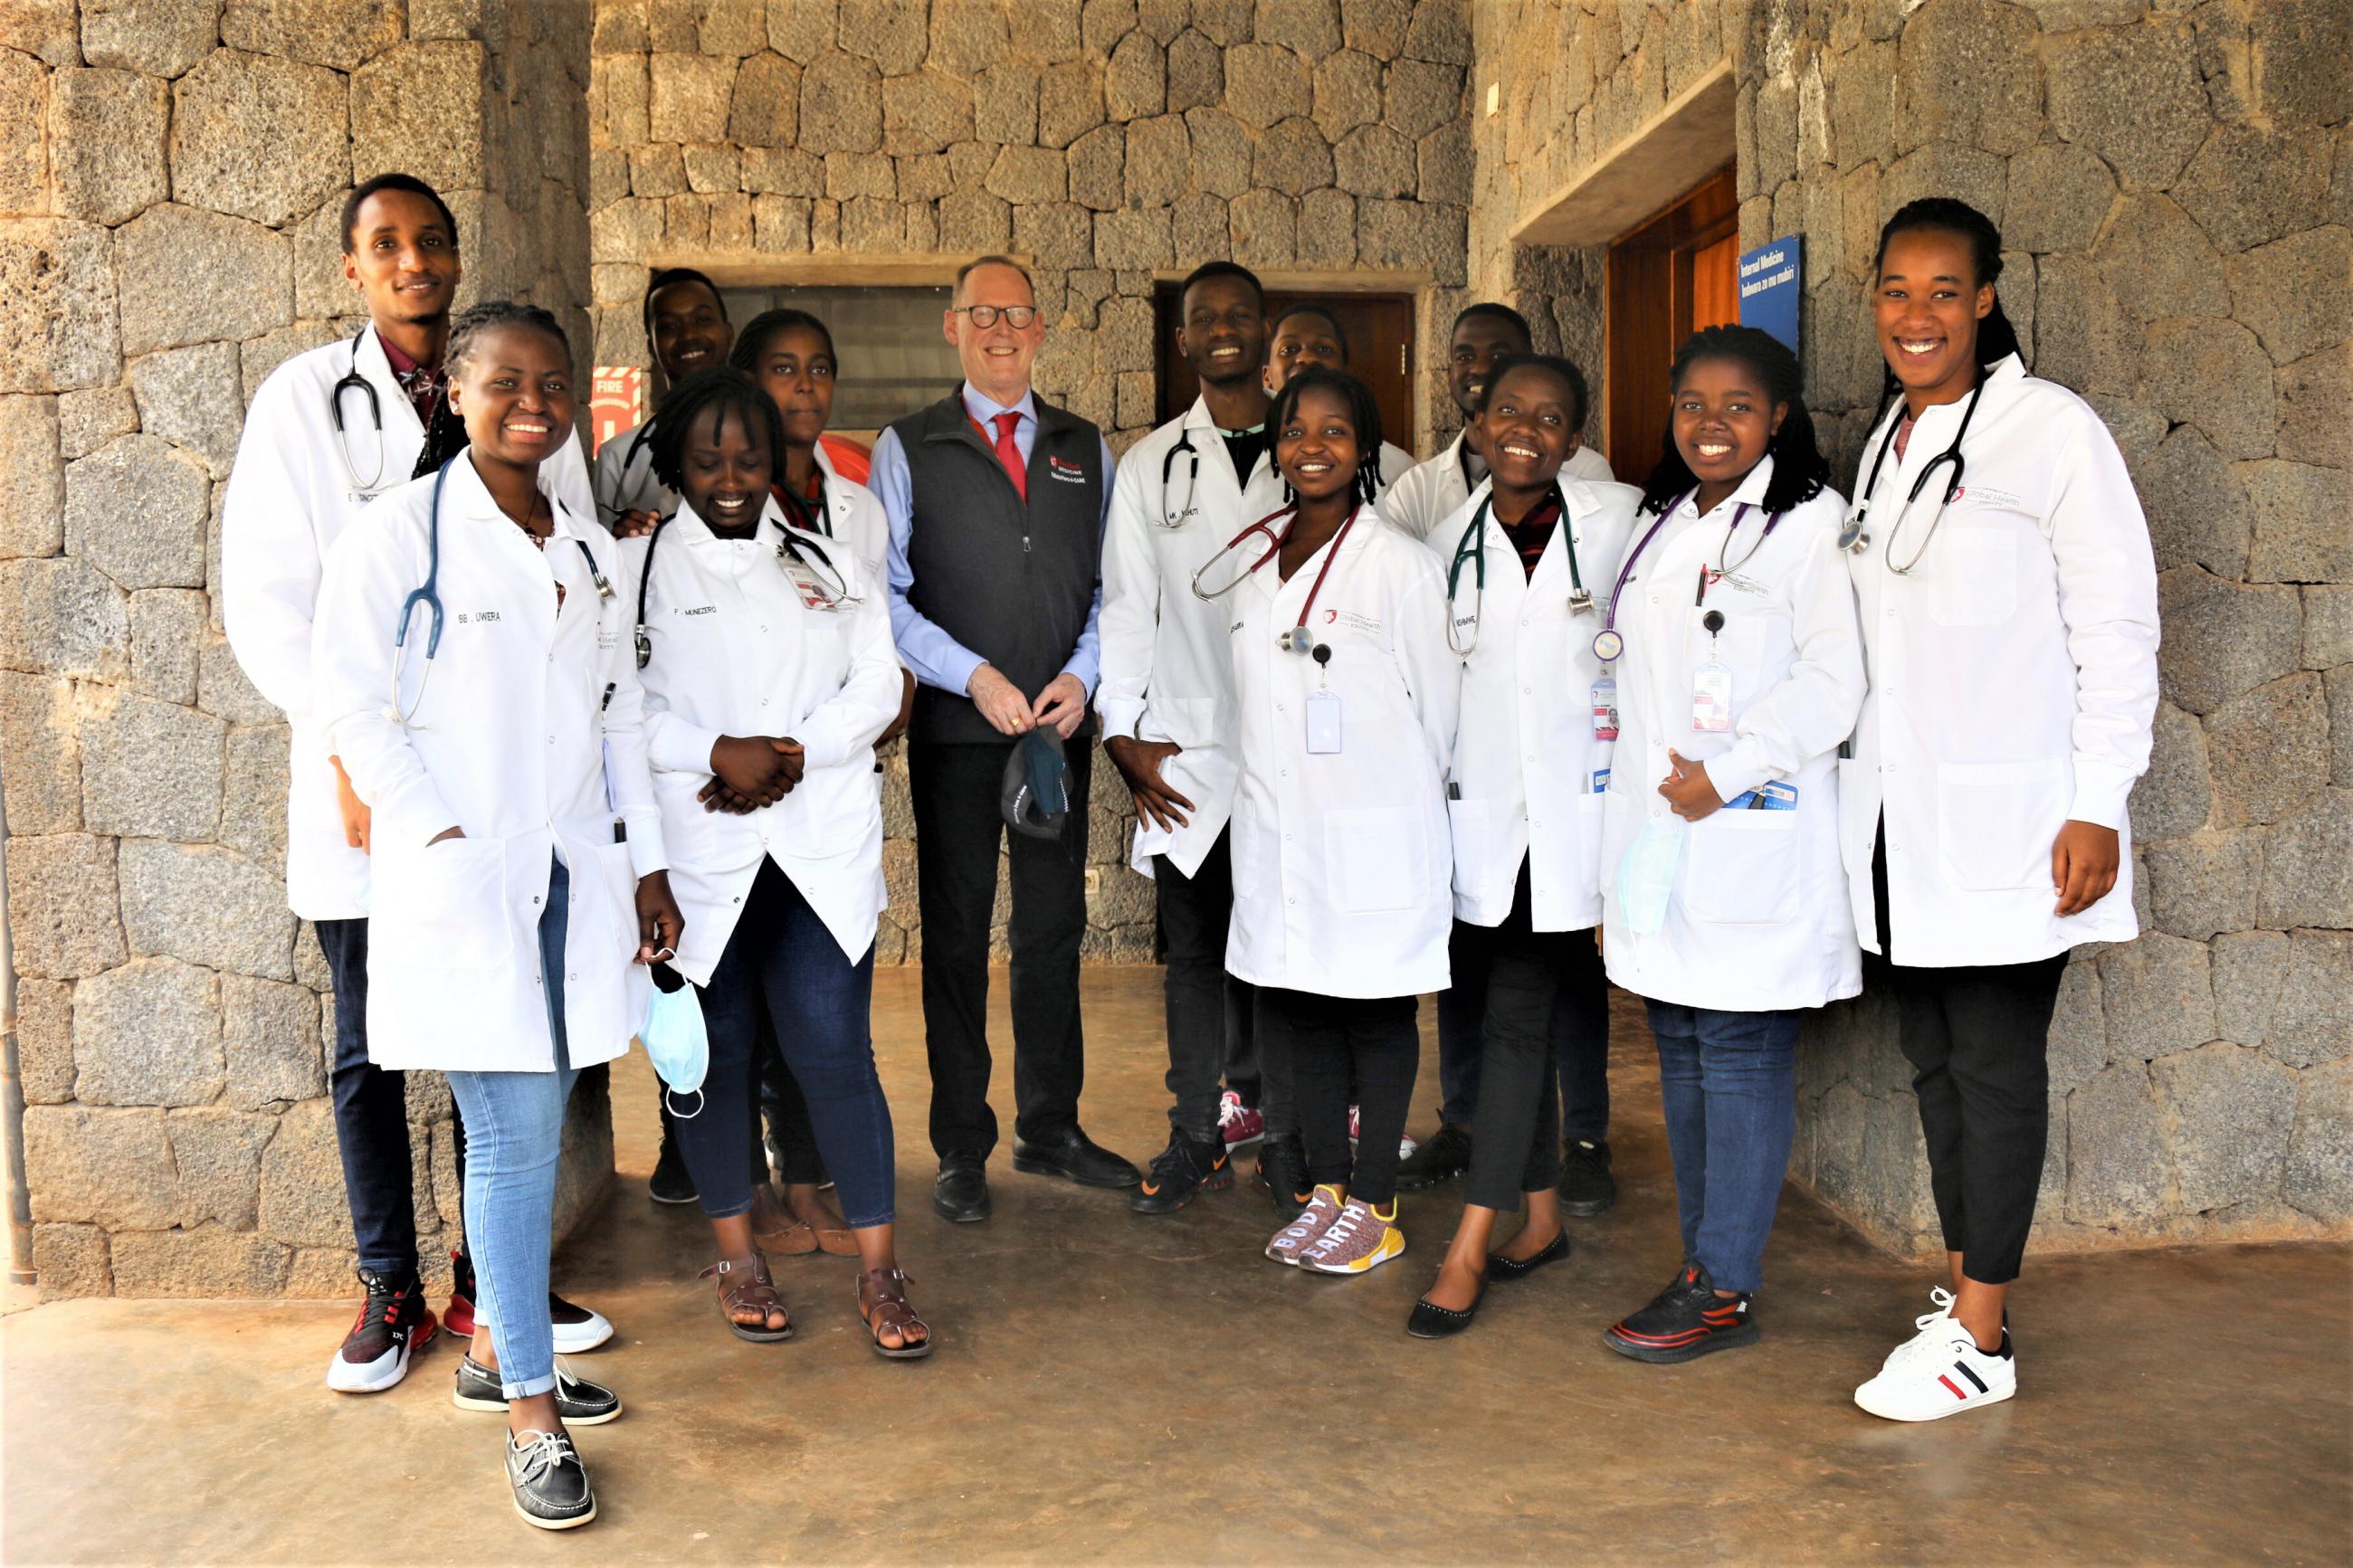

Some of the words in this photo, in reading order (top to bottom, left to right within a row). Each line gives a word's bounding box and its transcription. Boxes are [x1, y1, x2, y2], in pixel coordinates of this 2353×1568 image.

[1741, 257, 1760, 278] Internal
[1760, 250, 1784, 271] Medicine
[1741, 281, 1761, 299] Indwara
[1768, 275, 1777, 288] mu
[1777, 264, 1794, 284] mubiri
[596, 380, 624, 394] FIRE
[475, 612, 501, 622] UWERA
[685, 606, 717, 616] MUNEZERO
[1360, 619, 1381, 631] Health
[1273, 1197, 1327, 1249] BODY
[1300, 1204, 1366, 1259] EARTH
